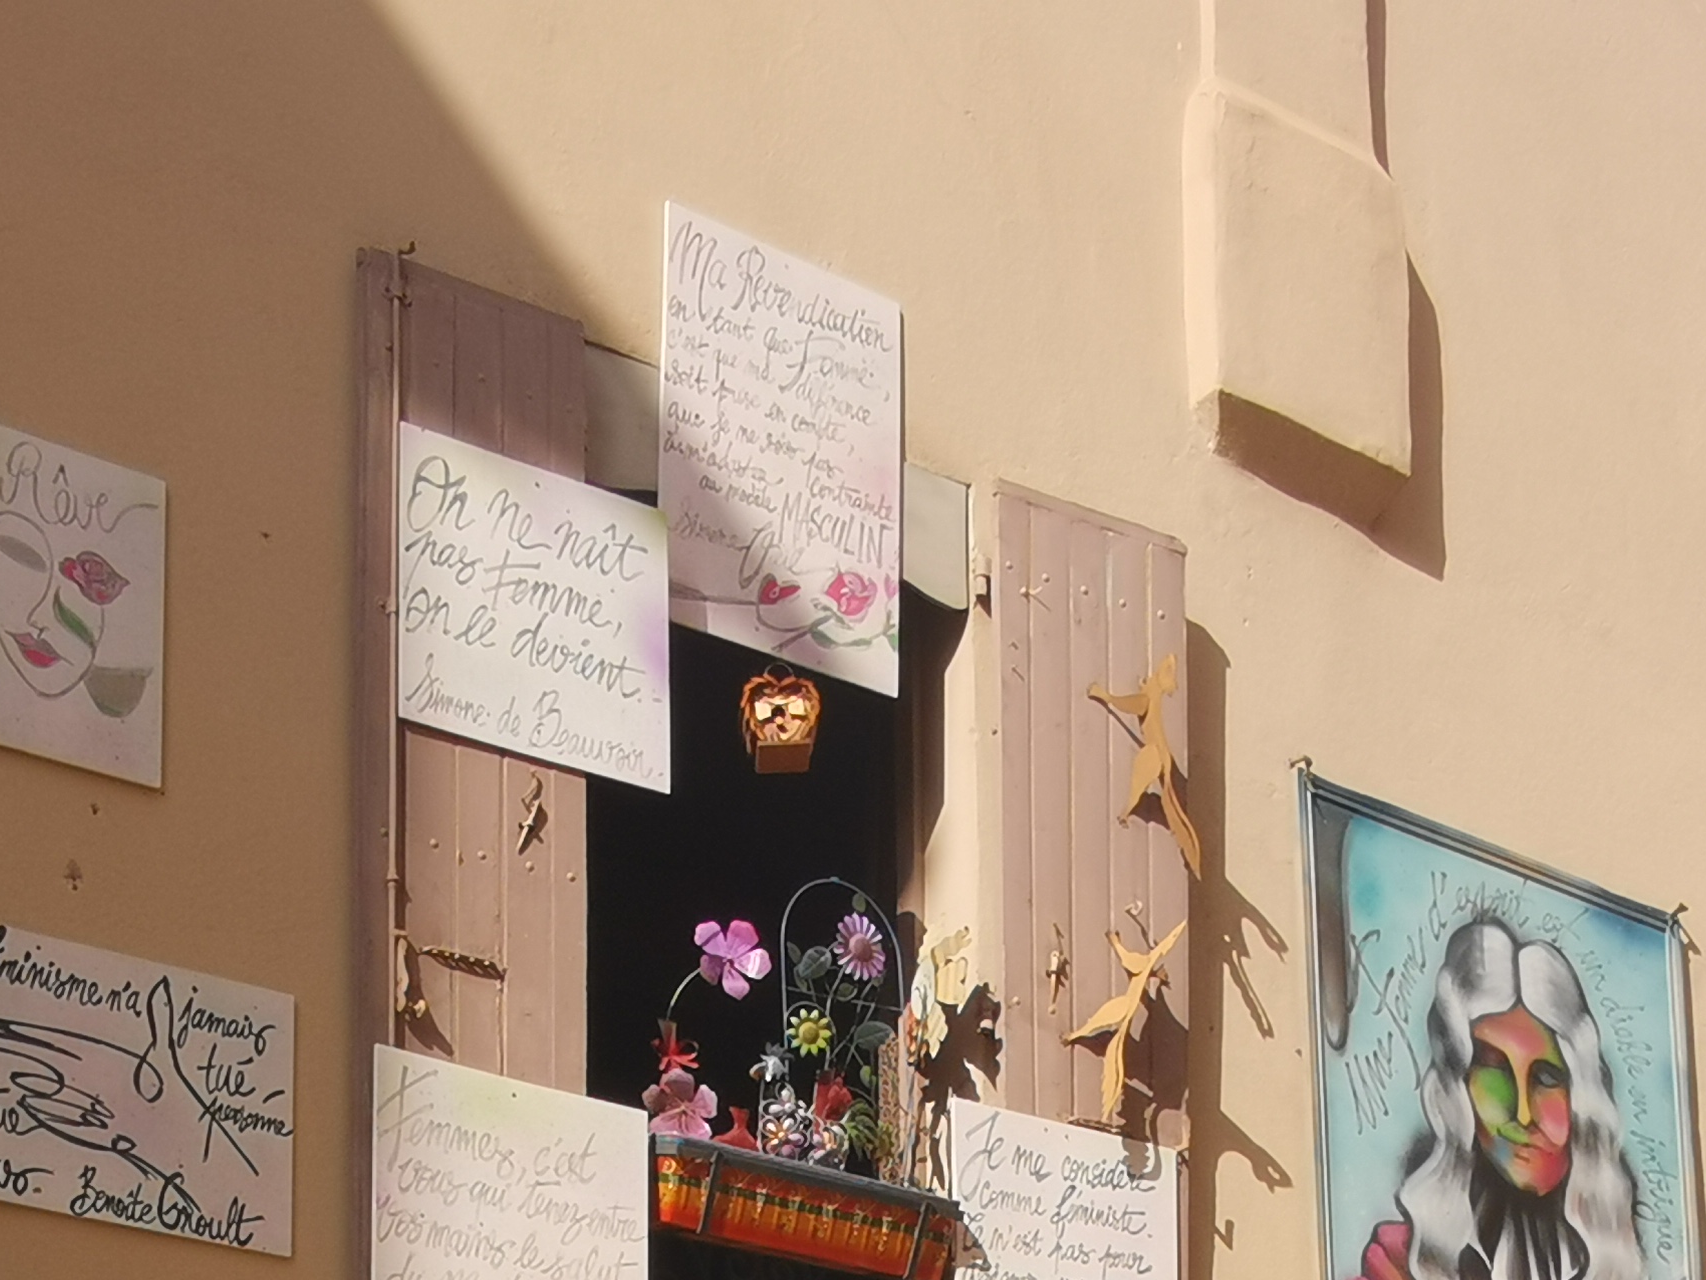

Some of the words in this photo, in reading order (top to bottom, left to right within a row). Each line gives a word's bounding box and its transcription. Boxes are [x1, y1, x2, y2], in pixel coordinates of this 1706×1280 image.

[406, 455, 475, 534] On
[488, 487, 552, 551] ne
[553, 516, 648, 583] naît
[777, 490, 893, 569] MASCULIN
[403, 529, 482, 599] pas
[456, 603, 497, 649] le
[497, 696, 521, 739] de
[105, 982, 142, 1018] n'a
[178, 986, 278, 1056] jamais
[196, 1044, 258, 1100] tué
